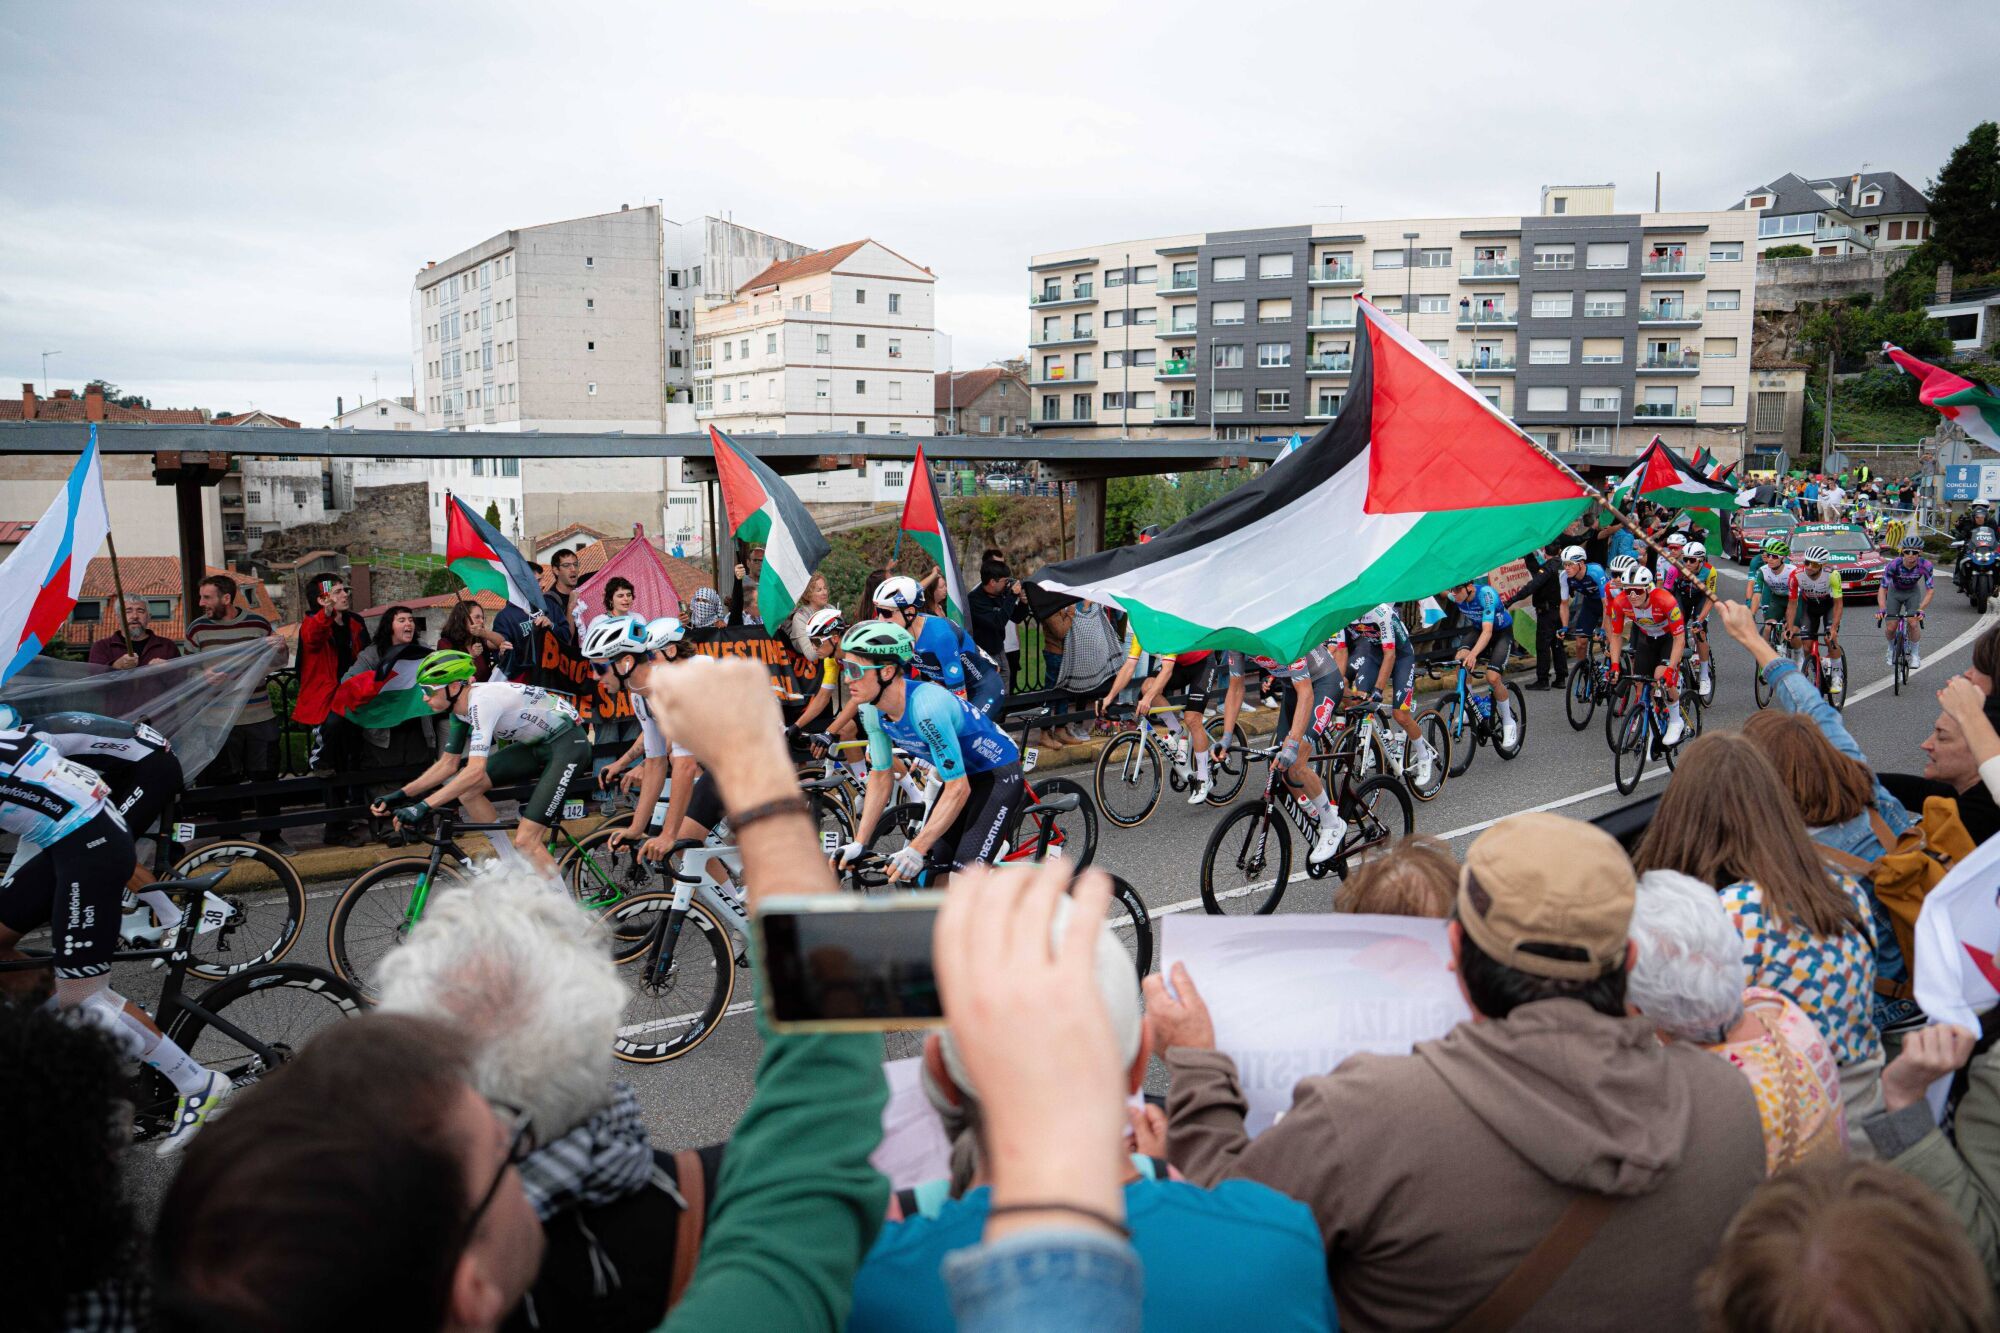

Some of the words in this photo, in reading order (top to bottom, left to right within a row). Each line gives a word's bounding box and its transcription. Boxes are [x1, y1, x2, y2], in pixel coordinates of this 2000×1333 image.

[1806, 524, 1850, 532] Fertiberia
[867, 646, 886, 655] VAN
[922, 717, 942, 741] AG2R
[545, 785, 566, 818] SEGUROS
[559, 762, 578, 787] RGA
[43, 796, 63, 814] Tech
[567, 804, 583, 818] 142
[1284, 793, 1320, 849] CANYON
[179, 824, 193, 839] 117
[979, 805, 1009, 858] DECATHLON
[825, 832, 838, 850] 114
[67, 881, 80, 930] Telefónica
[82, 904, 95, 930] Tech
[203, 910, 224, 926] 38
